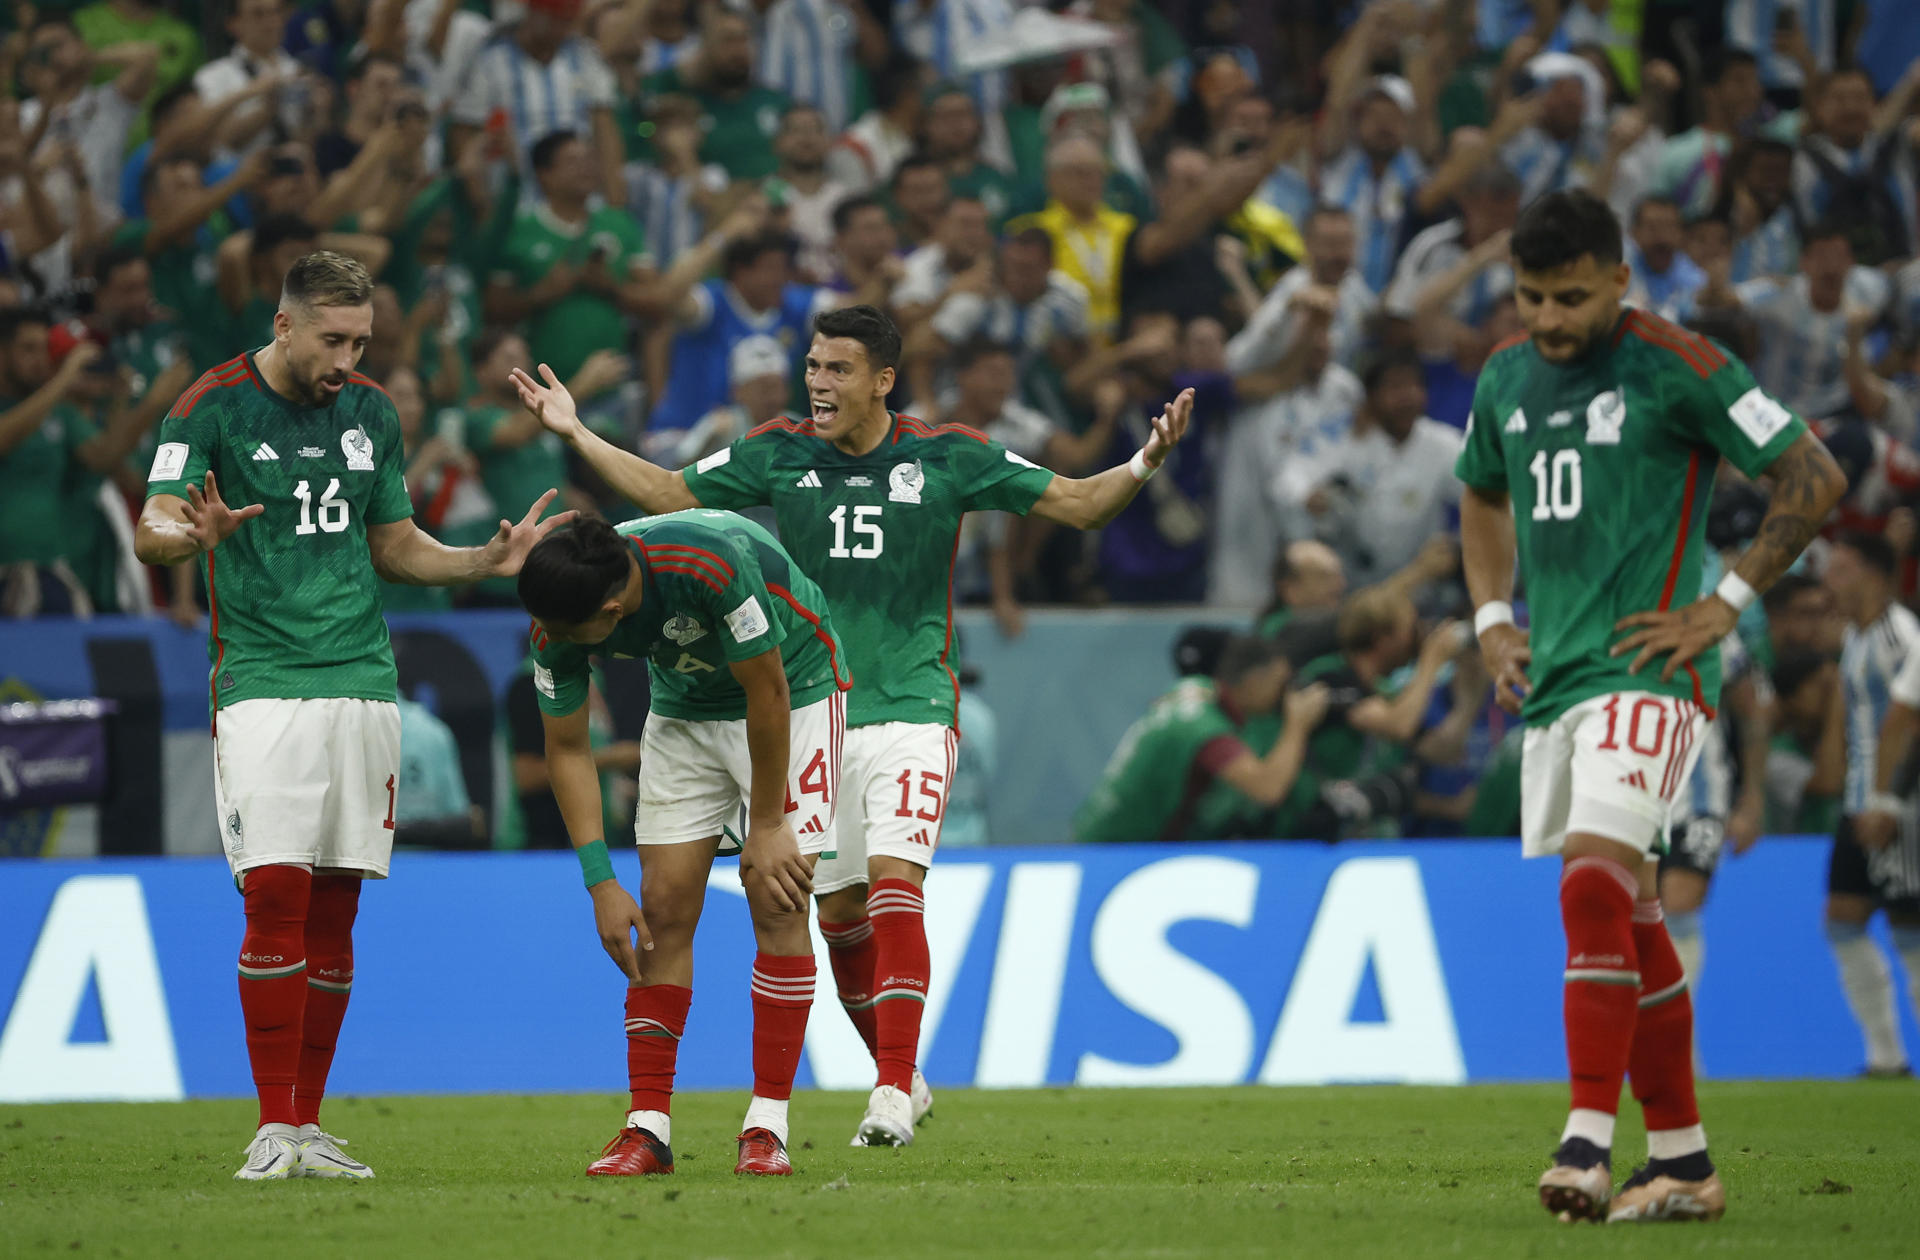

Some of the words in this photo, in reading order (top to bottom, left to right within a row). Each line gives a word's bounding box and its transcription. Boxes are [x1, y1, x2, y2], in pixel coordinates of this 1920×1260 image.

[293, 478, 349, 535] 16
[1529, 448, 1582, 520] 10
[828, 505, 883, 559] 15
[1598, 693, 1666, 758] 10
[895, 769, 943, 822] 15
[0, 874, 186, 1102] A
[711, 855, 1468, 1090] VISA
